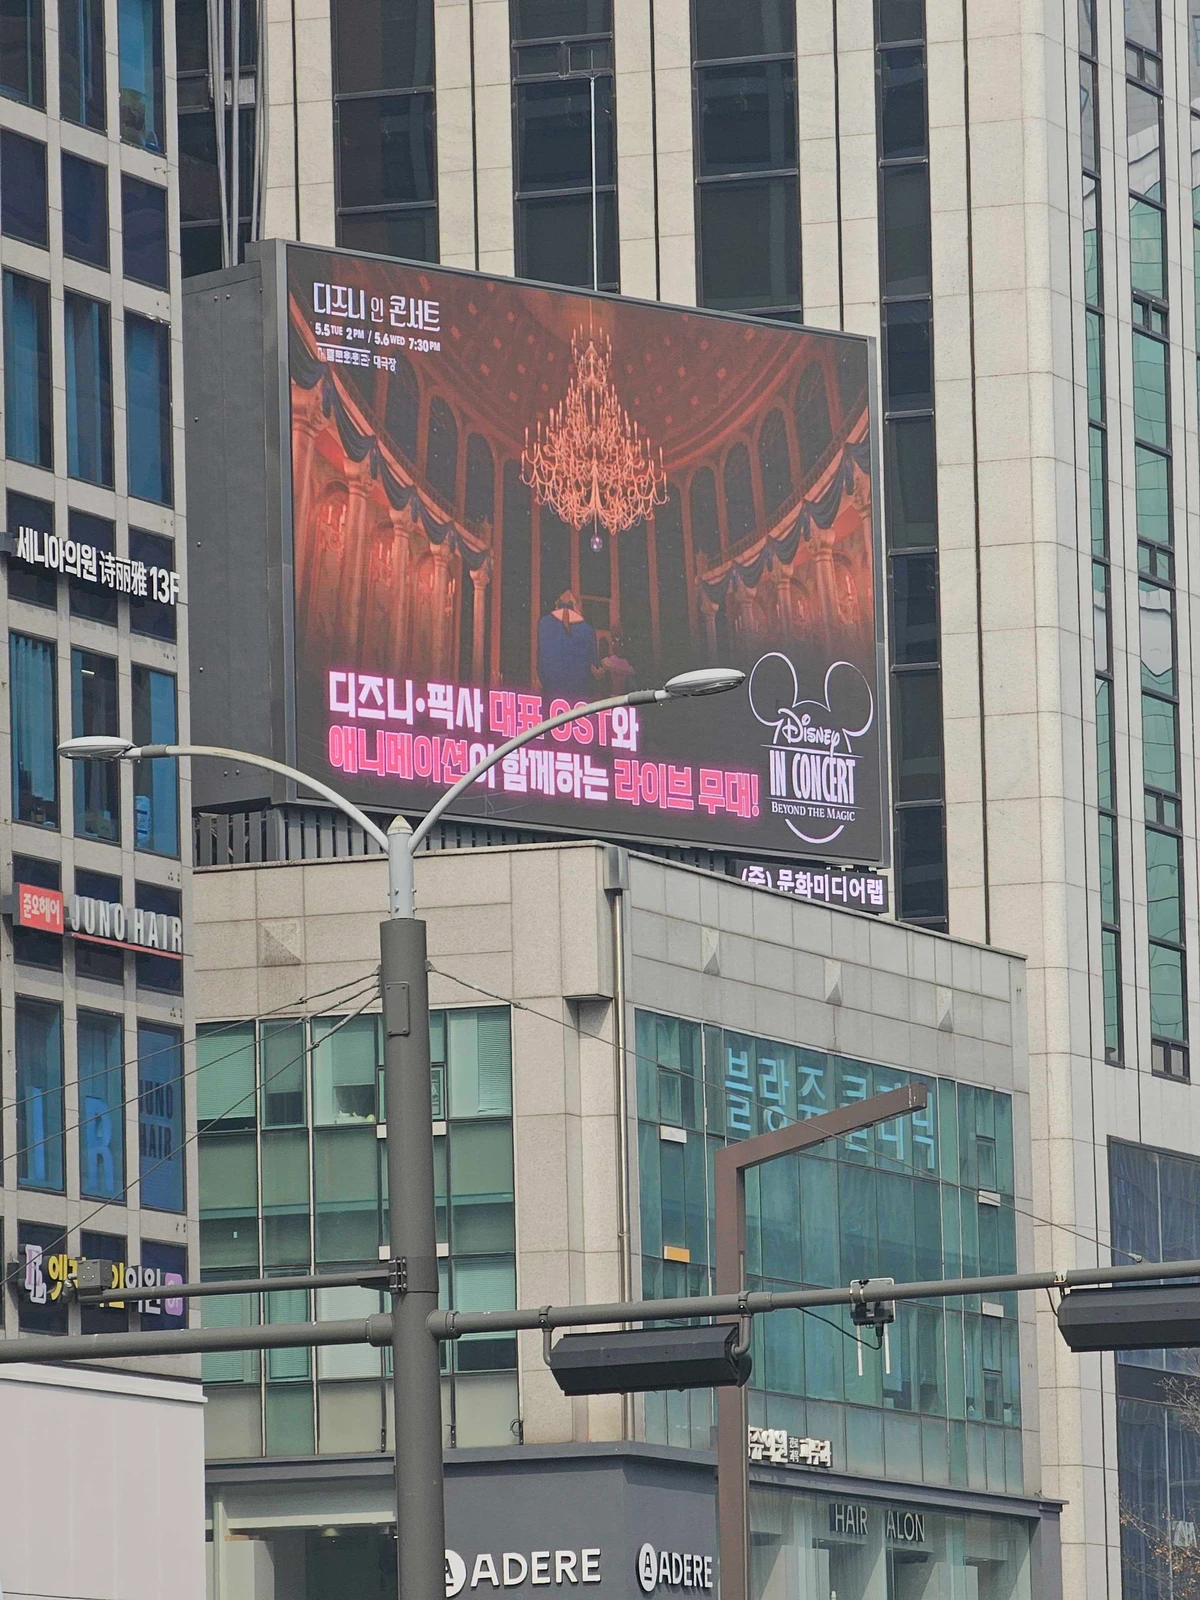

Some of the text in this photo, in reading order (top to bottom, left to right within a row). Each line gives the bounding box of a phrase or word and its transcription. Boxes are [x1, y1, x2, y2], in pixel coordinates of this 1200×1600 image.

[313, 282, 441, 332] 디즈니 인 콘서트
[373, 355, 397, 372] 대극장
[16, 526, 181, 606] 세니아의원 诗丽雅 13F
[489, 690, 545, 740] 대표
[550, 698, 639, 752] OST와
[329, 725, 760, 818] 애니메이션이 함께하는 라이브 무대!
[769, 750, 856, 804] IN CONCERT
[807, 807, 825, 818] THE
[741, 865, 884, 906] (주) 문화미디어랩
[23, 892, 61, 925] 준오헤어
[71, 894, 182, 953] JUNO HAIR
[835, 1503, 869, 1535] HAIR
[470, 1548, 601, 1588] ADERE
[659, 1550, 714, 1588] ADERE
